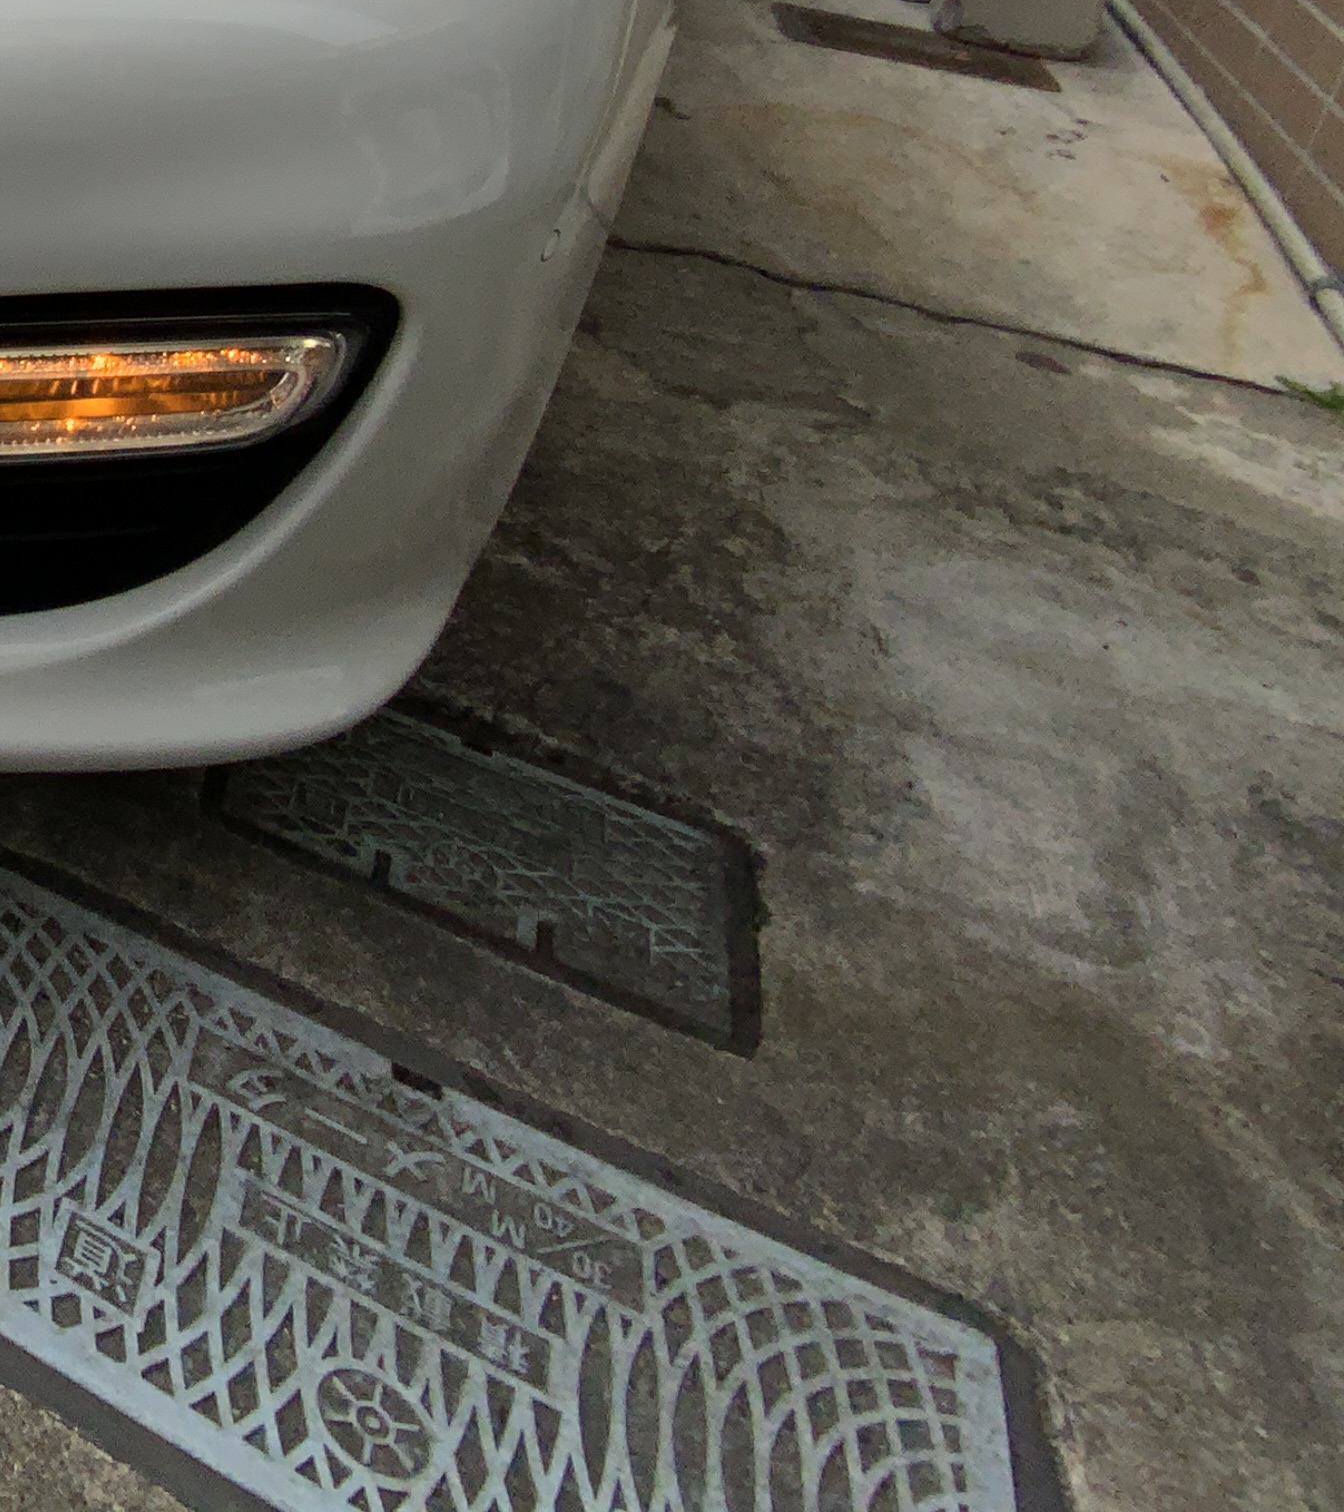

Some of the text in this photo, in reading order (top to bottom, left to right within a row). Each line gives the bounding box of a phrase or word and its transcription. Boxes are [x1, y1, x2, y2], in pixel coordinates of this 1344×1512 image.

[63, 1219, 137, 1302] 道
[262, 1191, 530, 1374] 積載禁止
